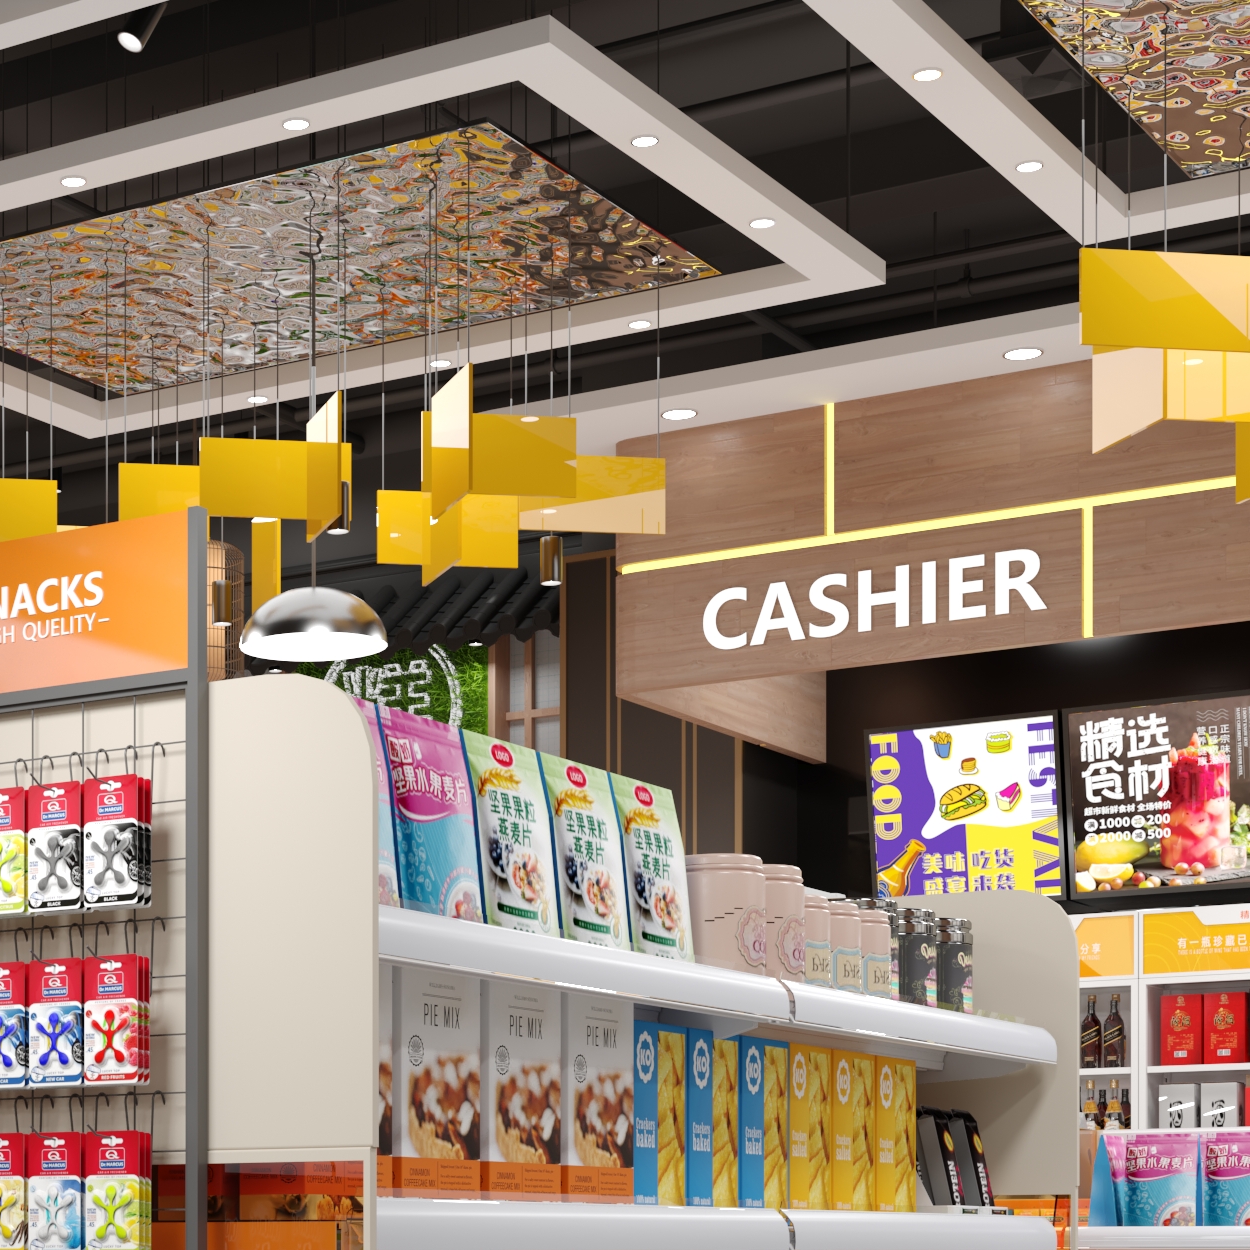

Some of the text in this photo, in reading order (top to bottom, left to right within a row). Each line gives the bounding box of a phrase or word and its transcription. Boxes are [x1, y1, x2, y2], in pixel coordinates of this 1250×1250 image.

[703, 548, 1047, 650] CASHIER
[1079, 713, 1171, 762] 精选
[494, 752, 510, 763] LOGO
[393, 765, 468, 805] 坚果水果麦片
[570, 772, 583, 784] LOGO
[870, 733, 902, 840] FOOD
[1081, 755, 1174, 803] 食材
[1084, 800, 1171, 816] 超市新鲜食材 全场特价
[564, 809, 608, 841] 坚果果粒
[1099, 813, 1170, 829] 1000 200
[633, 827, 674, 858] 坚果果粒
[1147, 828, 1171, 839] 500
[641, 853, 670, 880] 燕麦片
[922, 851, 966, 874] 美味
[972, 849, 1015, 869] 吃货
[1080, 943, 1102, 954] 分享
[423, 1003, 461, 1030] PIE MIX
[509, 1014, 543, 1040] PIE MIX
[635, 1129, 656, 1149] baked
[1126, 1156, 1193, 1172] 坚果水果麦片
